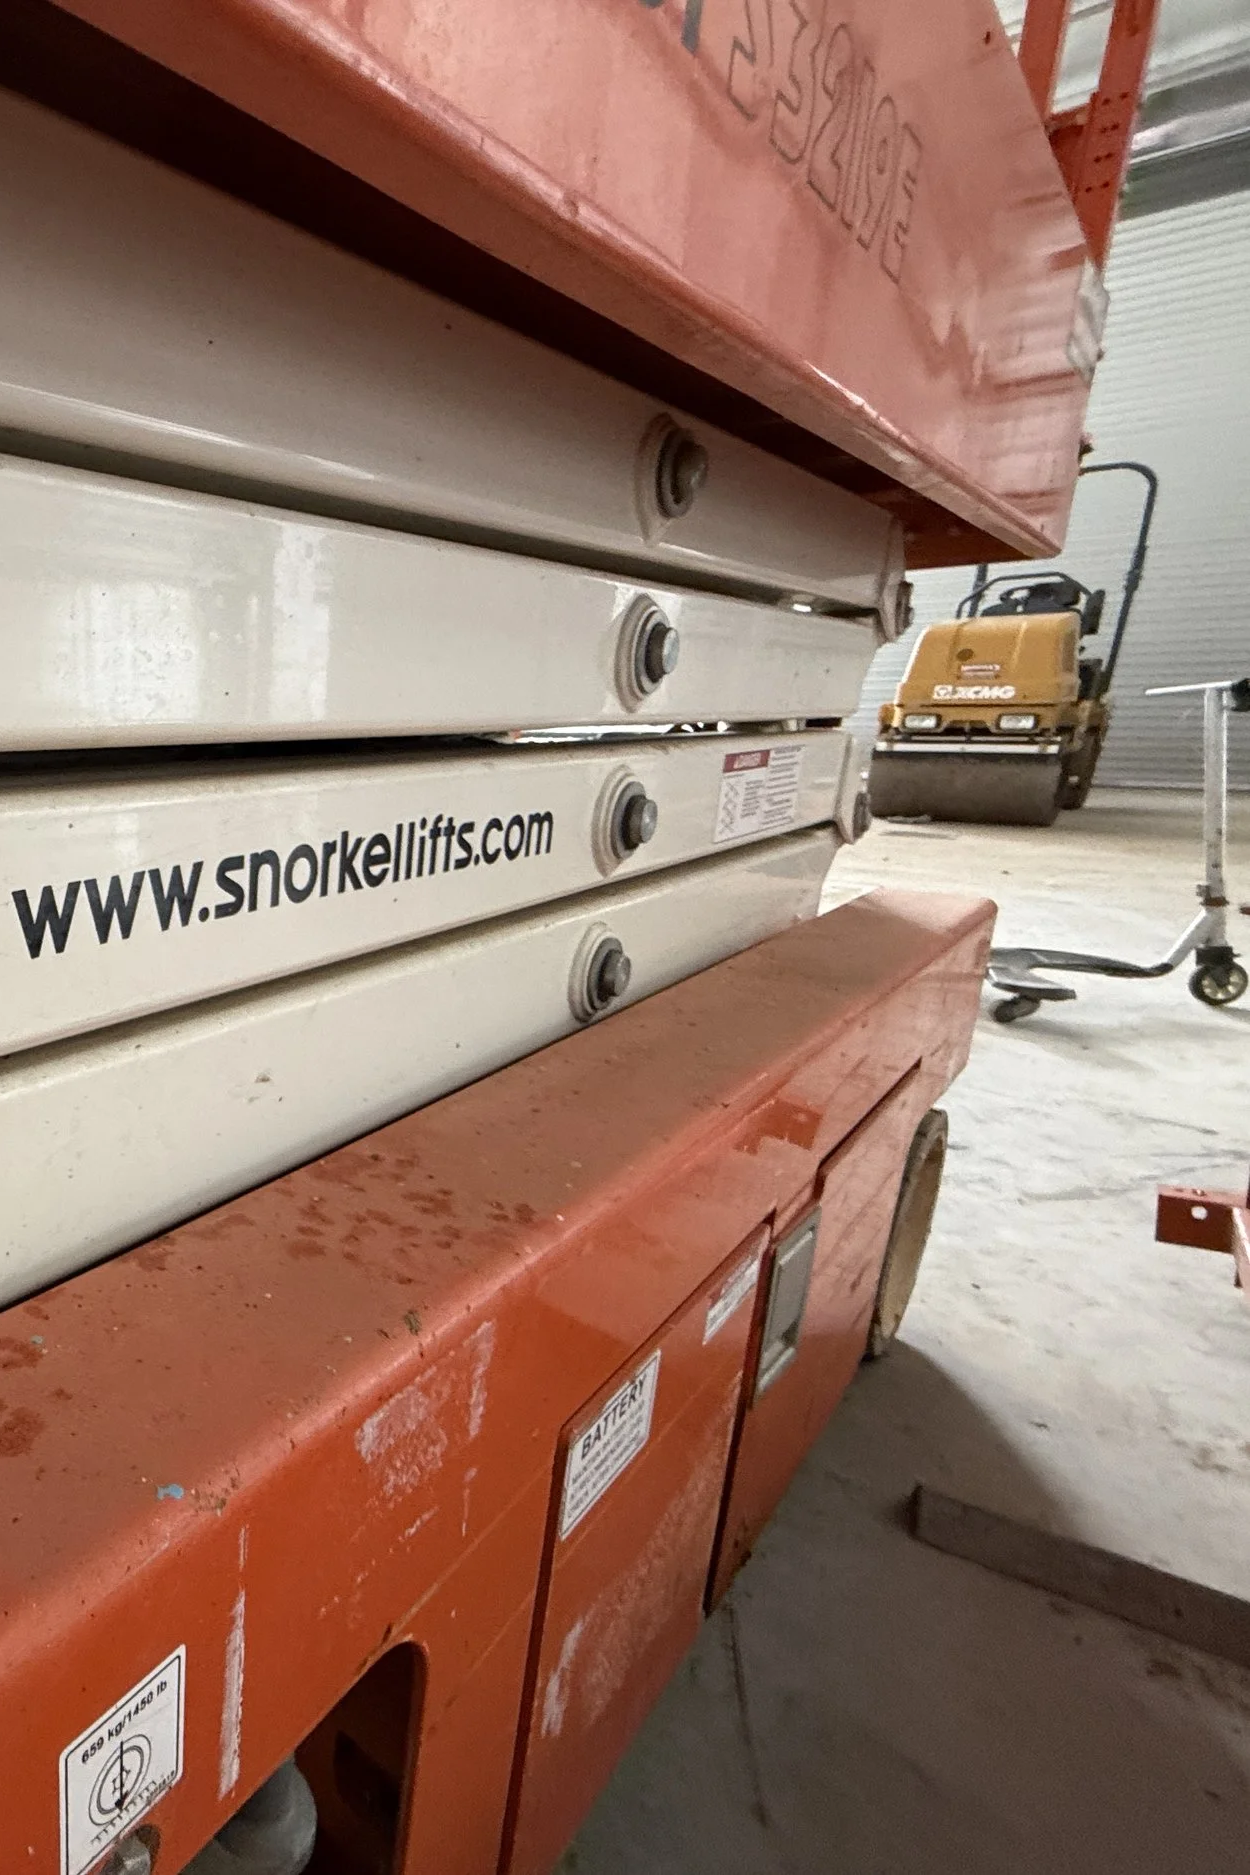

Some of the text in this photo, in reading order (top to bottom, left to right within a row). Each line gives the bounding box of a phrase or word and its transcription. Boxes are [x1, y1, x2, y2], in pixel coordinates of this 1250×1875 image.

[12, 811, 554, 960] www.snorkellifts.com
[581, 1373, 647, 1460] BATTERY
[82, 1680, 168, 1764] 659 kg/1450 lb
